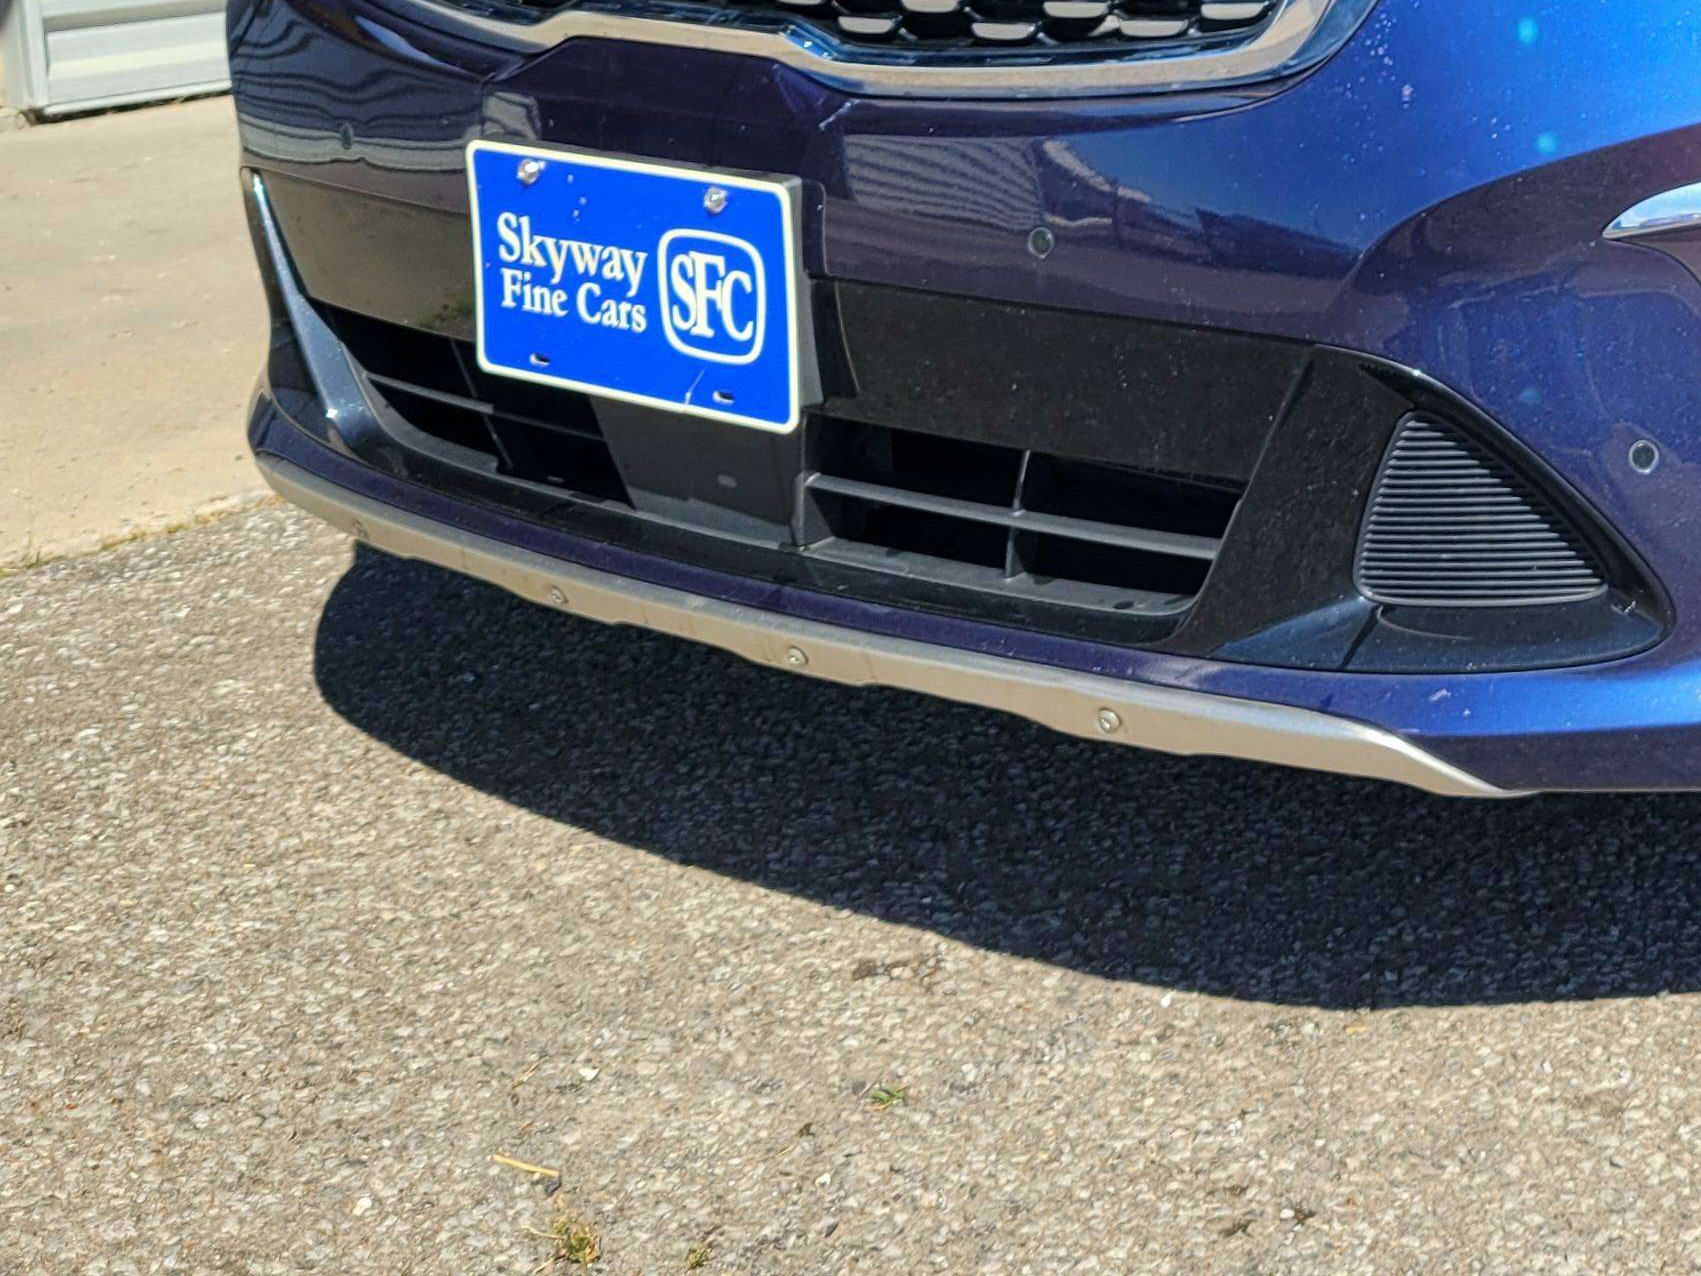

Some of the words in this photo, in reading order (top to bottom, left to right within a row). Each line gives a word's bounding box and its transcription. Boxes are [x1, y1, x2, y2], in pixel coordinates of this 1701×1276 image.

[497, 212, 648, 297] Skyway
[670, 250, 753, 342] SFC
[501, 268, 569, 317] Fine
[577, 282, 647, 333] Cars
